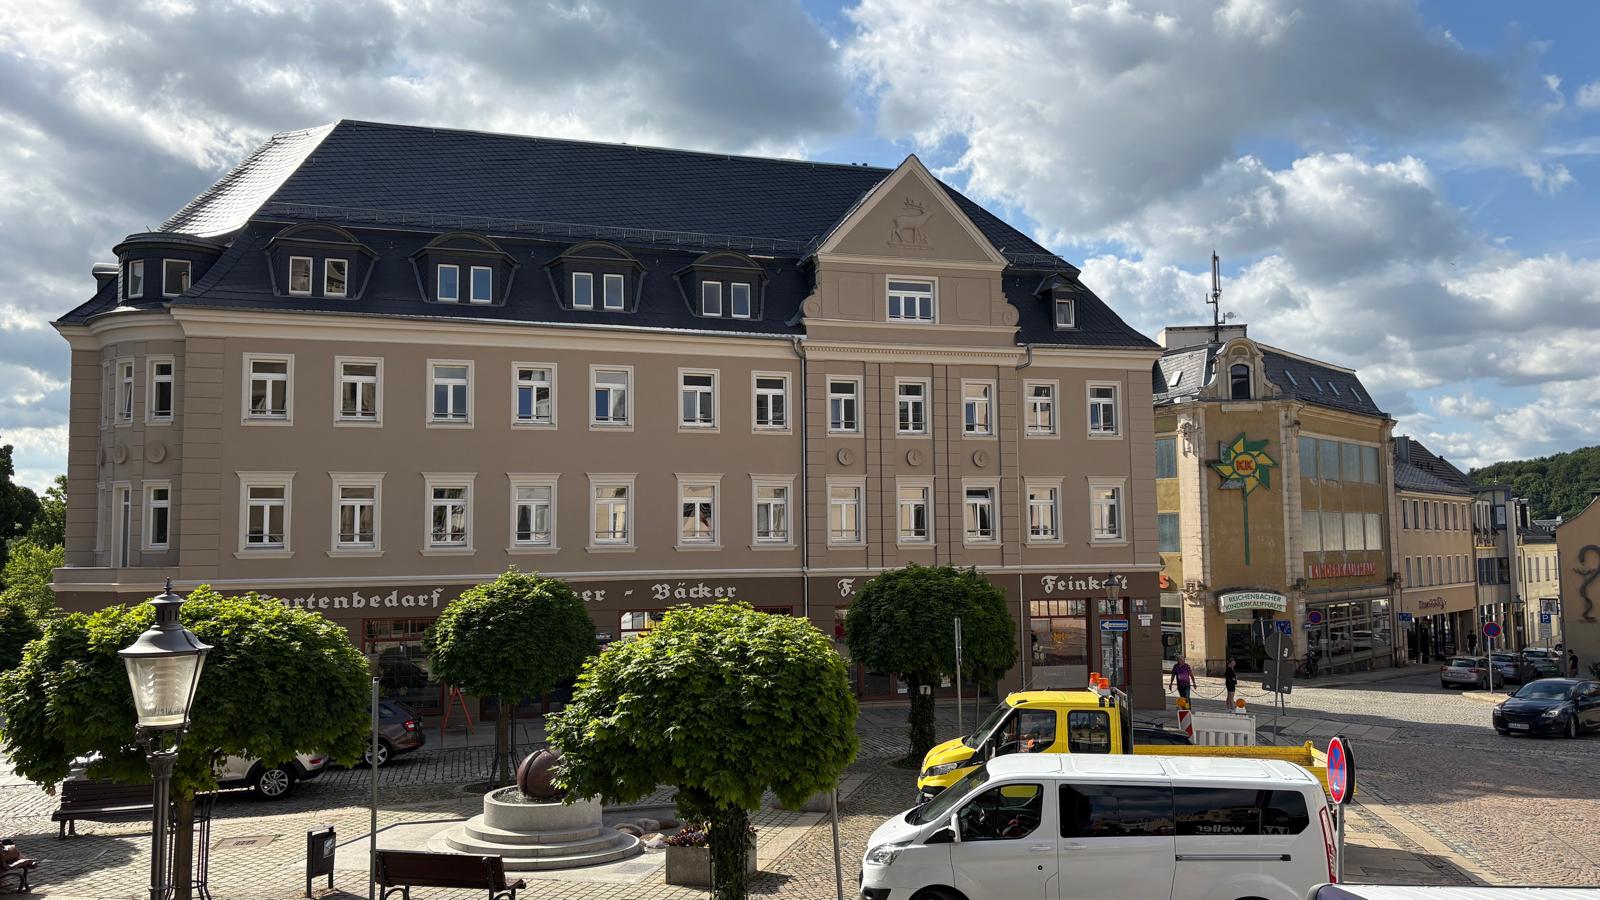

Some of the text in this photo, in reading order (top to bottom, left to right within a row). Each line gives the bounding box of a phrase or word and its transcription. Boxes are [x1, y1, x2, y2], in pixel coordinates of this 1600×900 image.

[1236, 460, 1253, 470] KK
[651, 582, 738, 600] Bäcker
[1228, 593, 1282, 603] REICHENBACHER
[1225, 601, 1283, 611] KINDERKAUFHAUS
